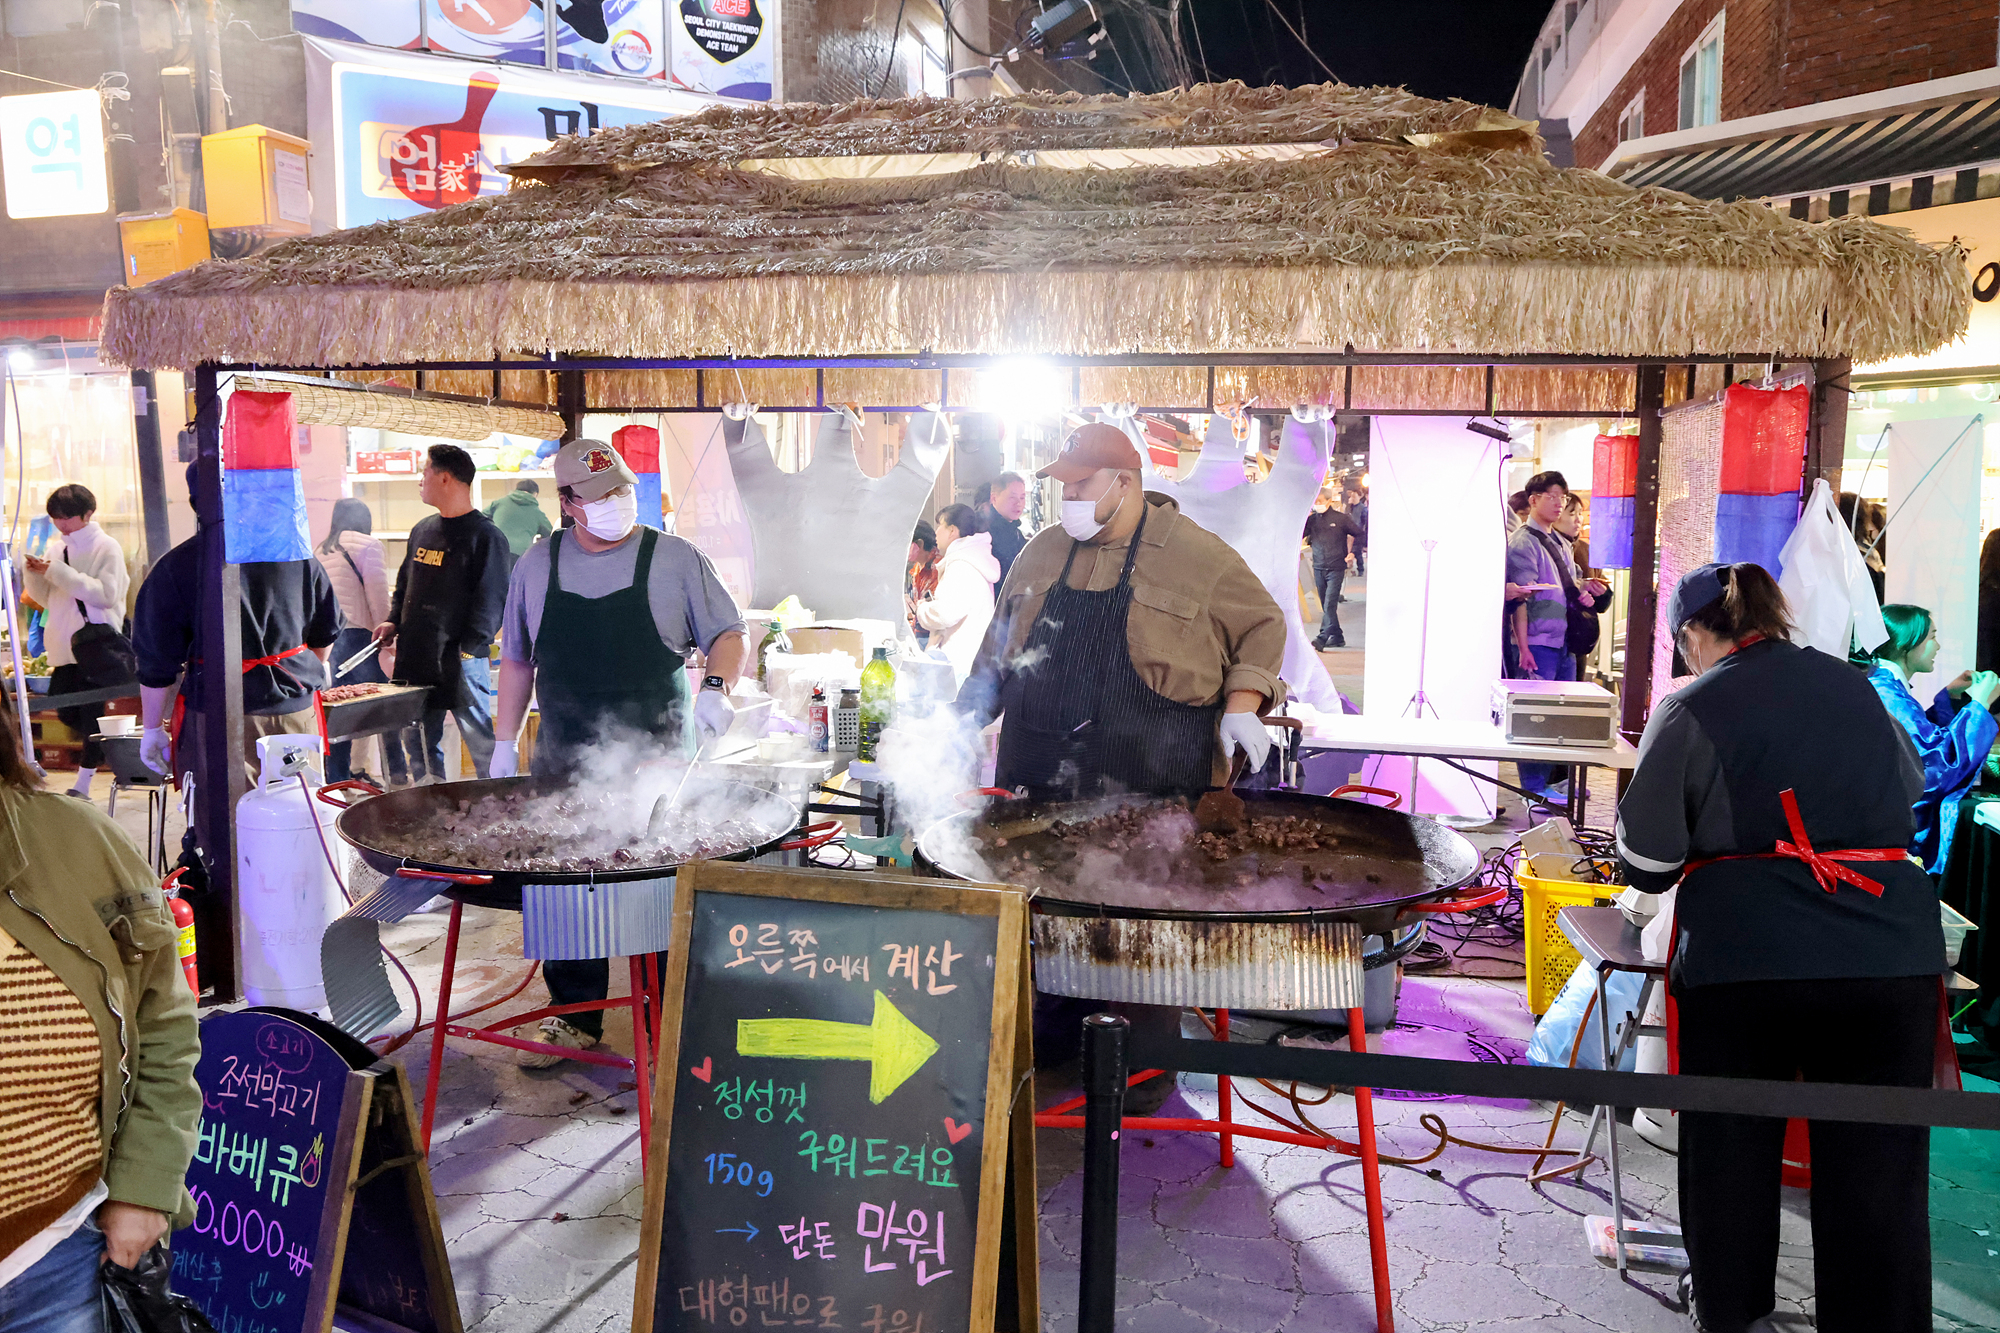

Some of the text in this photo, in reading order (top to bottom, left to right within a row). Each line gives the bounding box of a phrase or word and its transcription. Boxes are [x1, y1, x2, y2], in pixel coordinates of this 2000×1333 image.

[684, 15, 759, 36] SEOUL CITY TAEKWONDO
[696, 28, 748, 44] DEMONSTRATION
[706, 41, 738, 53] ACE TEAM
[25, 113, 84, 191] 역
[724, 924, 964, 996] 오른쪽에서 계산
[217, 1054, 322, 1126] 조선막고기
[713, 1076, 807, 1124] 정성껏
[195, 1117, 301, 1208] 바베큐
[703, 1153, 774, 1197] 150g
[798, 1130, 959, 1187] 구워드려요
[778, 1200, 953, 1287] 단돈 만원
[679, 1274, 842, 1328] 대형팬으로
